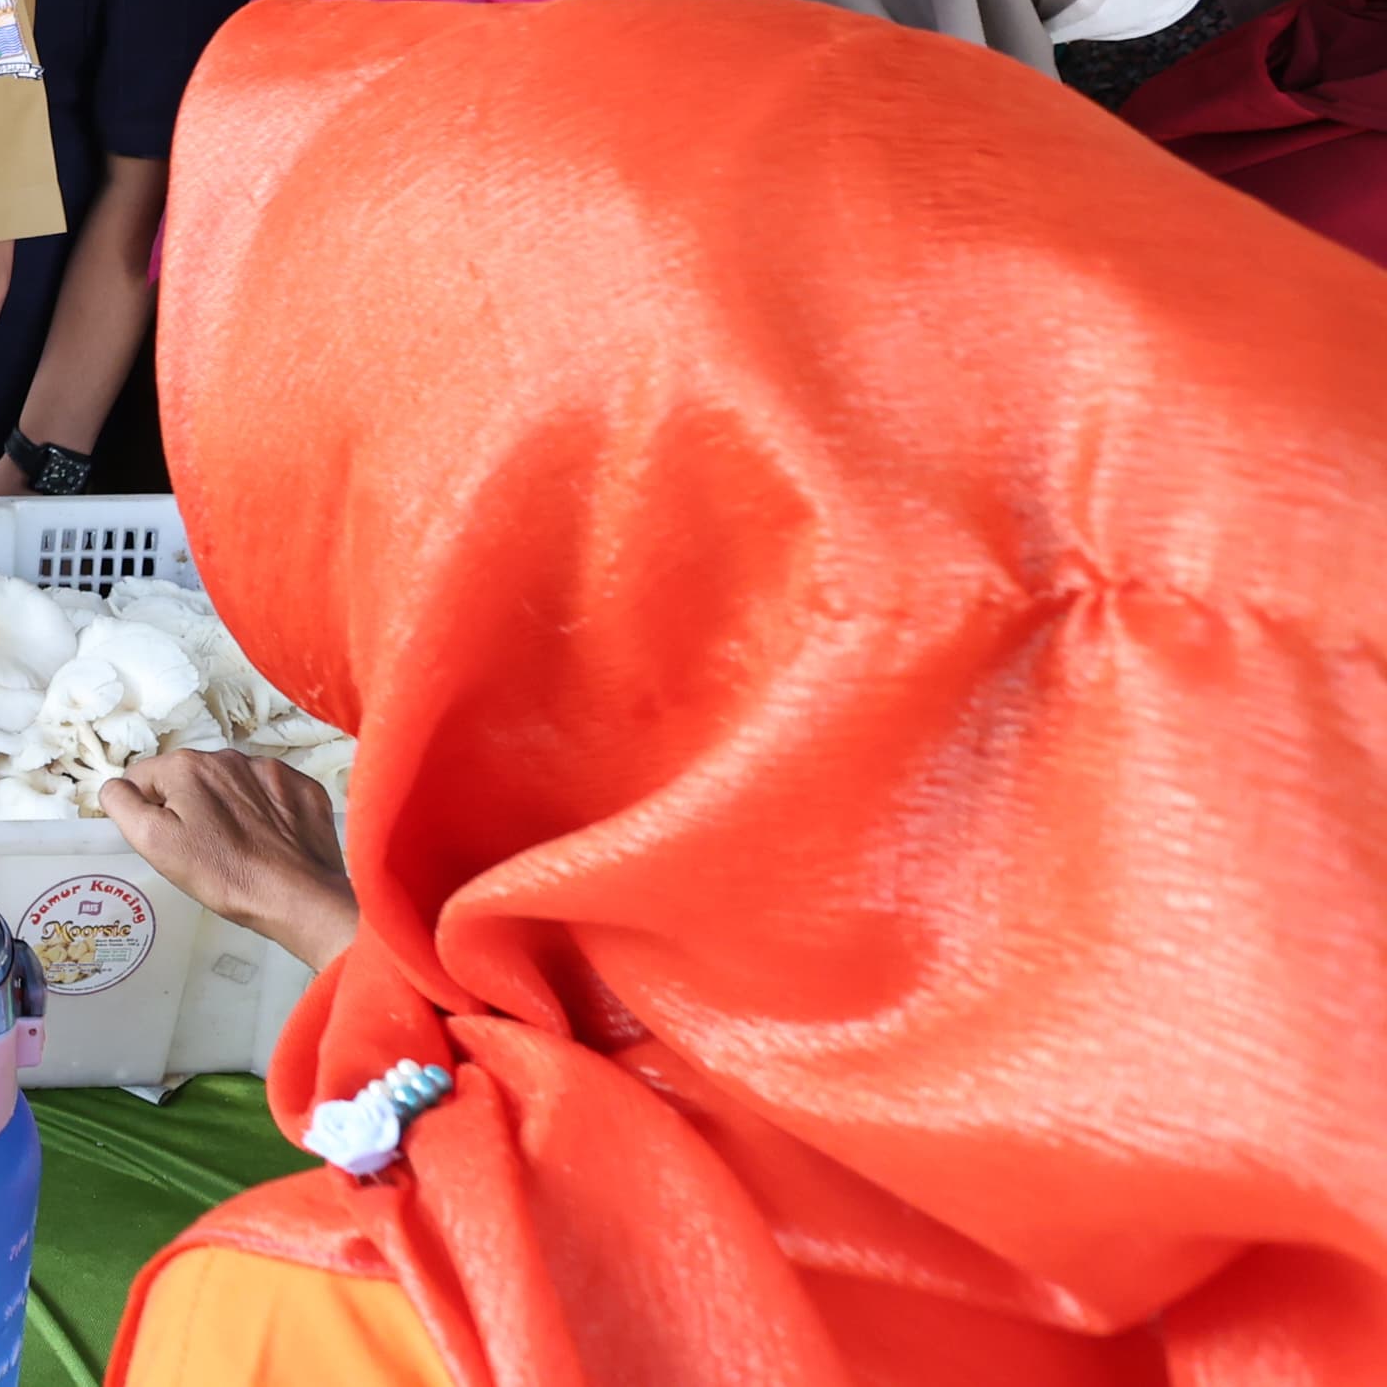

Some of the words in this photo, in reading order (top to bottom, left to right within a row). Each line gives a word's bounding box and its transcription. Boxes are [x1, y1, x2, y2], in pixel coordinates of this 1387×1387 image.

[29, 884, 81, 925] Jamur
[90, 880, 147, 924] Kancing
[41, 920, 132, 942] Moorsie
